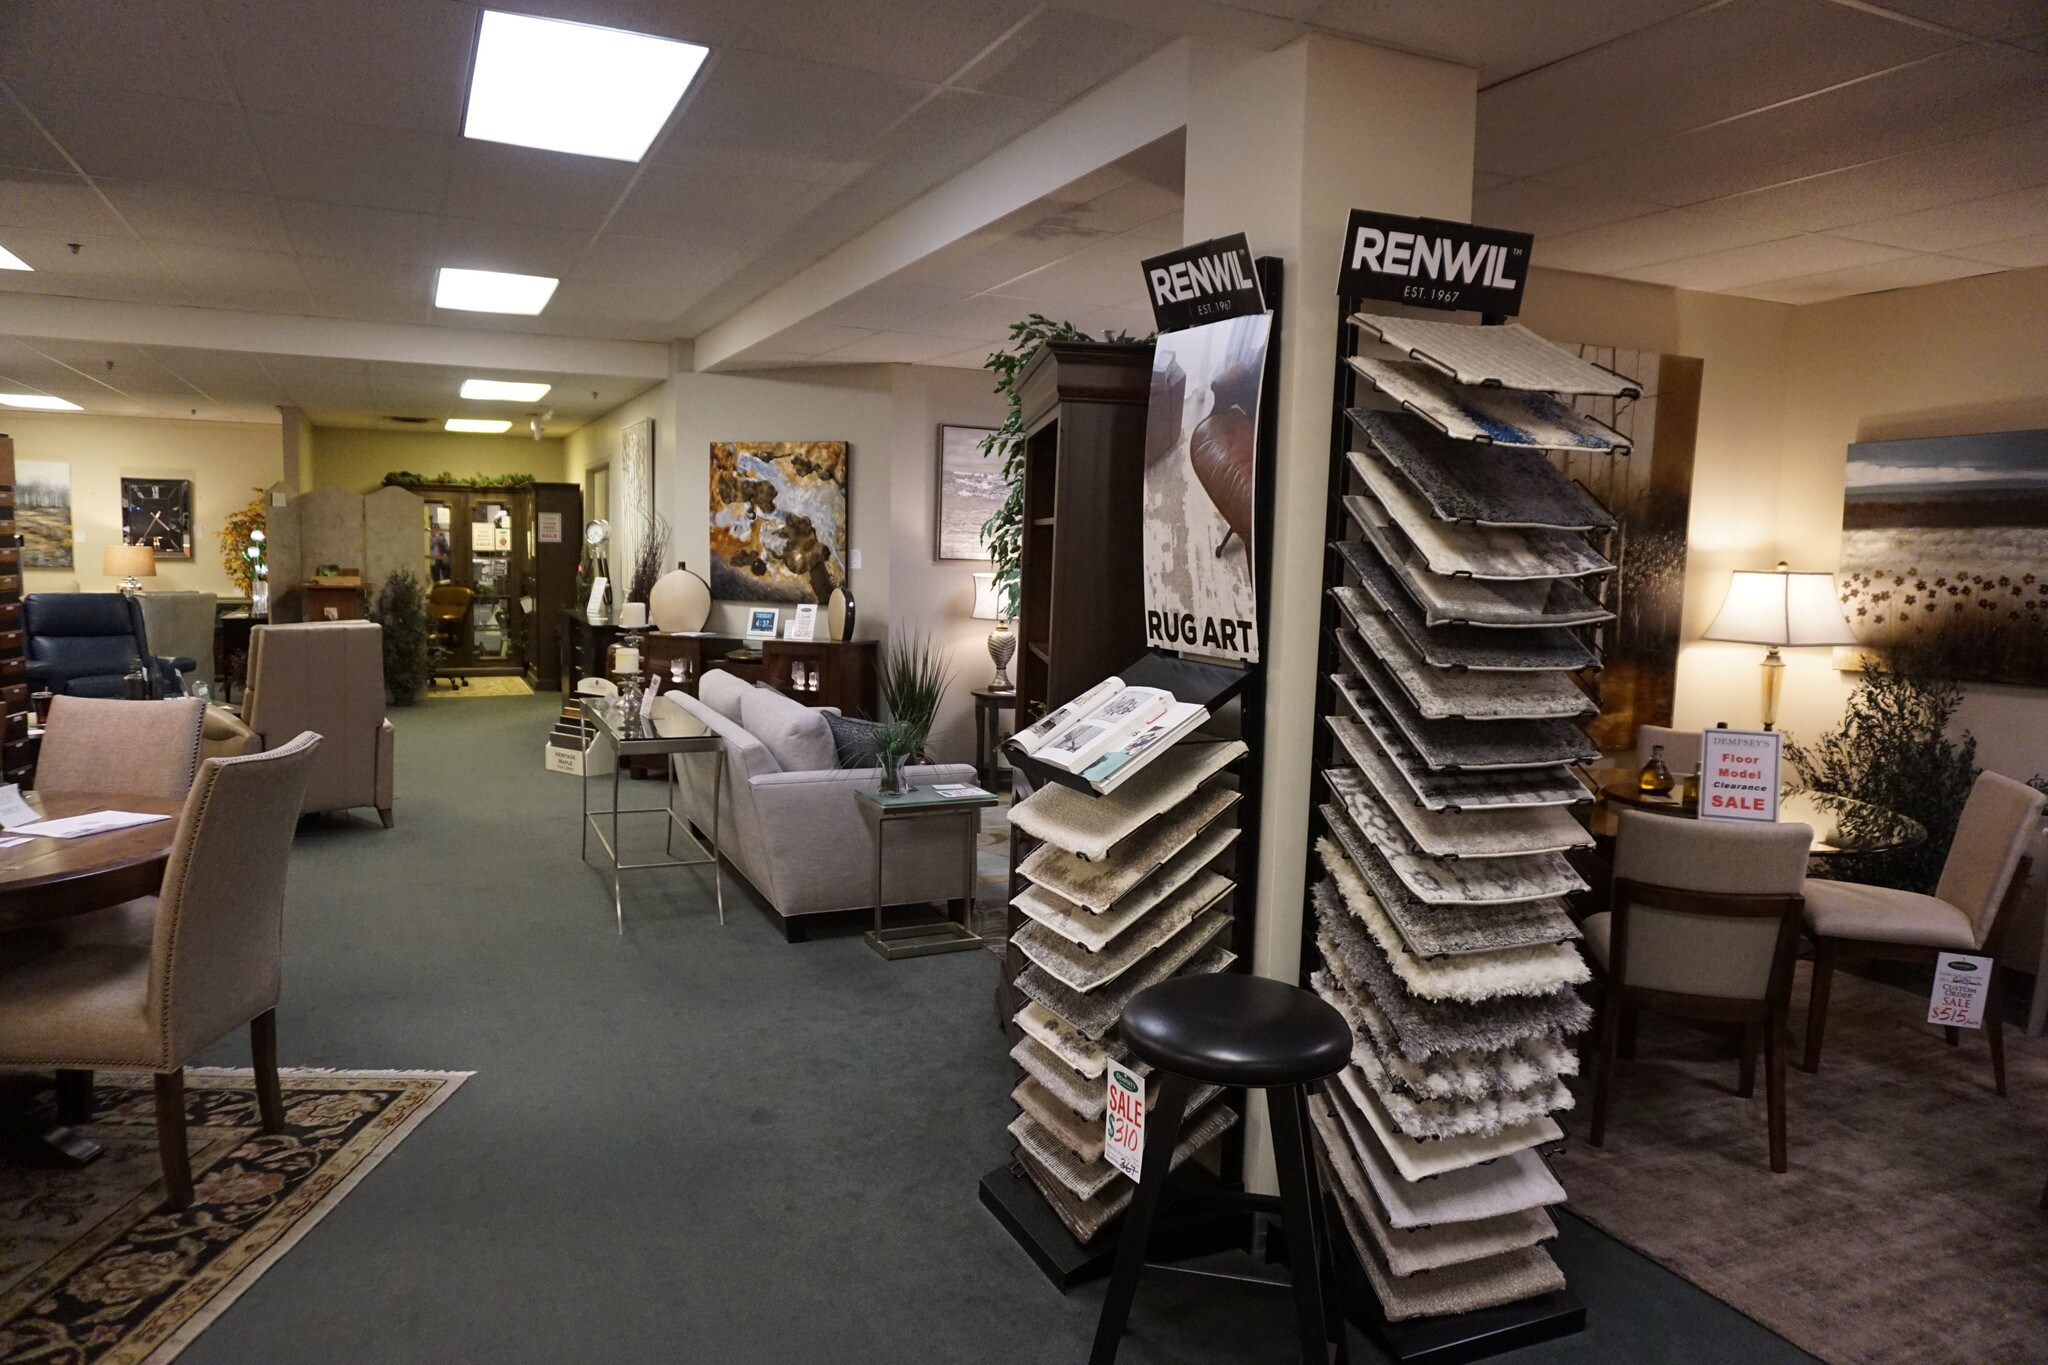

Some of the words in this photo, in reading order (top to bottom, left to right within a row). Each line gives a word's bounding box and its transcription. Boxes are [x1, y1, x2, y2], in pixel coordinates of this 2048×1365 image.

[1351, 226, 1516, 290] RENWIL
[1150, 250, 1253, 305] RENWIL
[1404, 285, 1426, 299] EST.
[1431, 289, 1460, 303] 1967
[1198, 304, 1214, 316] EST.
[1215, 300, 1231, 312] 1967
[1148, 610, 1196, 645] RUG
[1202, 616, 1253, 653] ART
[1713, 737, 1770, 748] DEMPSEY'S
[1722, 753, 1760, 764] Floor
[1718, 768, 1761, 779] Model
[1713, 781, 1767, 792] Clearance
[1711, 795, 1765, 811] SALE
[1943, 984, 1977, 994] CUSTOM
[1944, 991, 1973, 999] ORDER
[1942, 997, 1971, 1008] SALE
[1109, 1084, 1142, 1129] SALE
[1108, 1112, 1138, 1152] $310
